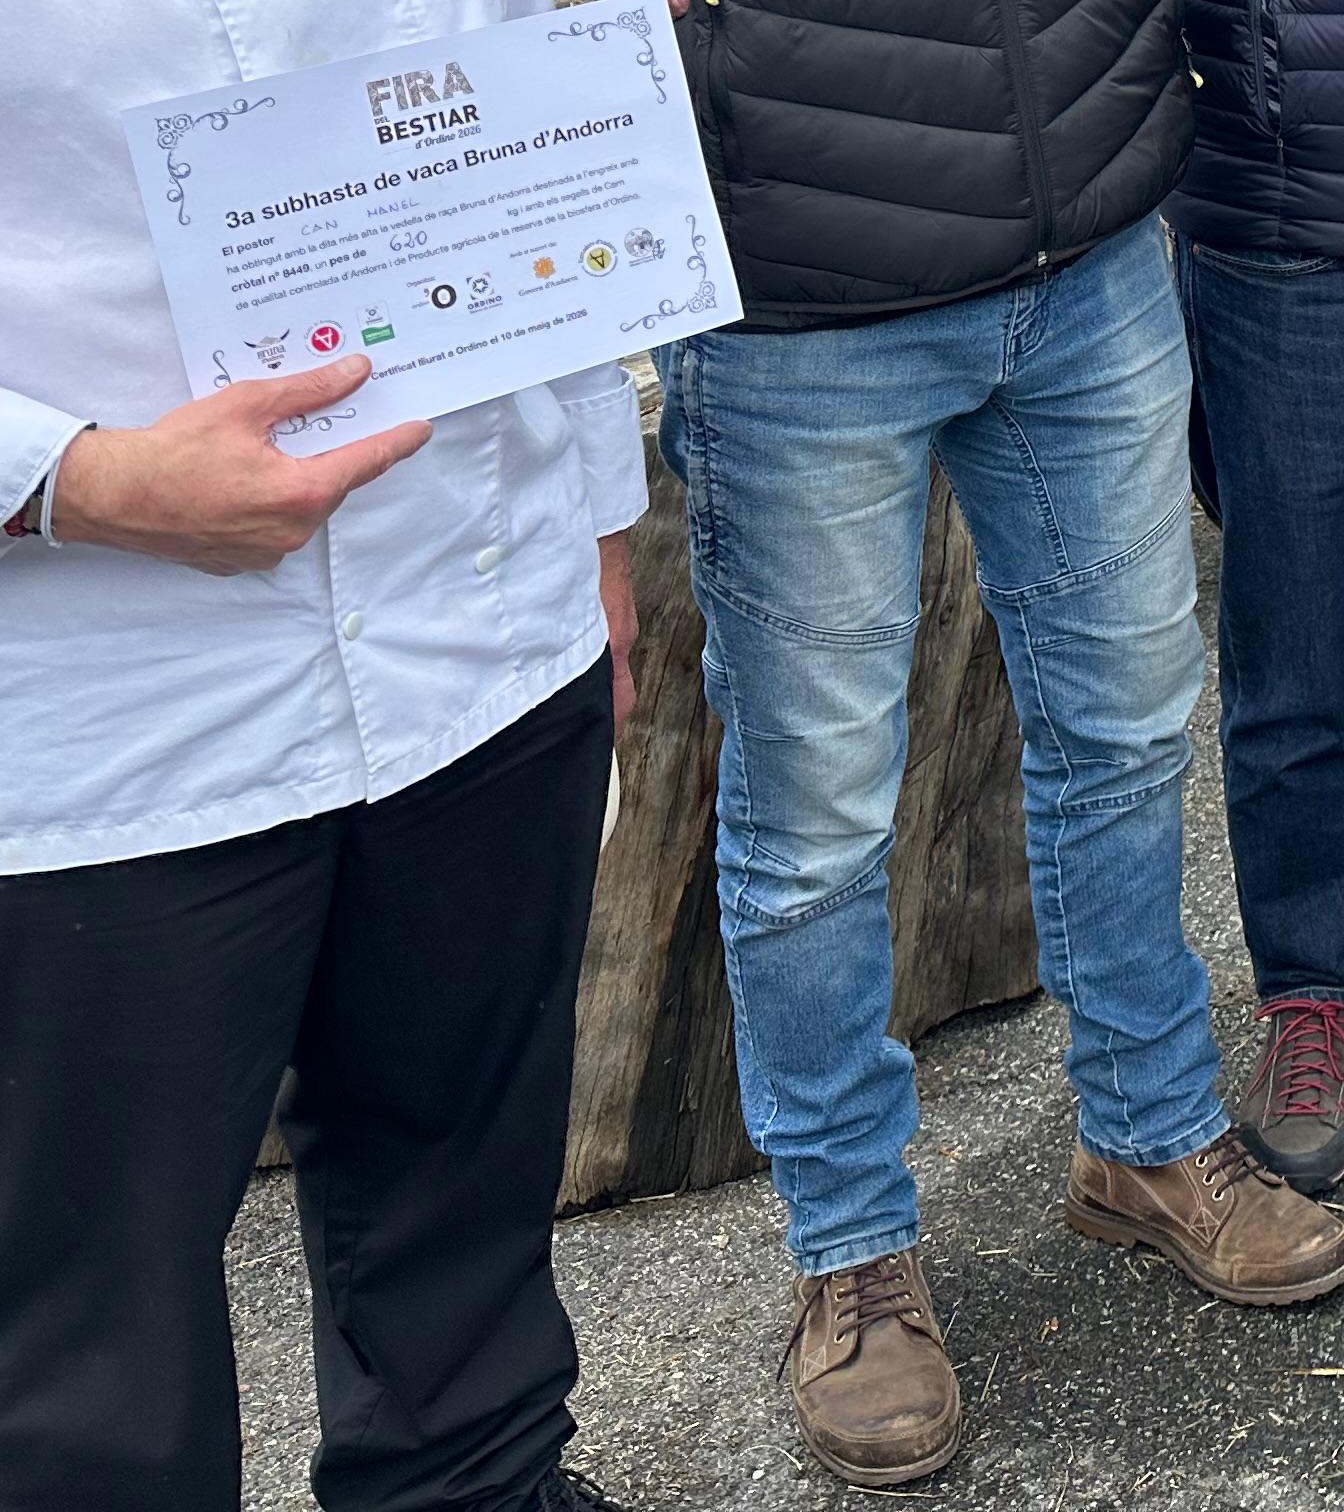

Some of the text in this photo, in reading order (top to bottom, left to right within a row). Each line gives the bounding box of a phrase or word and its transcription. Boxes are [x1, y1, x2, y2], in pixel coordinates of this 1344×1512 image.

[366, 62, 472, 115] FIRA
[377, 104, 478, 144] BESTIAR
[457, 124, 481, 138] 2026
[225, 114, 633, 228] 3a subhasta de vaca Bruna d'Andorra
[225, 265, 240, 274] ha
[241, 253, 281, 270] obtingut
[284, 247, 306, 259] amb
[424, 212, 436, 221] de
[459, 199, 486, 211] Bruna
[487, 187, 531, 203] d'Andorra
[532, 175, 575, 191] destinada
[300, 198, 419, 235] CAN MANEL
[506, 208, 519, 216] kg
[221, 236, 274, 256] El postor
[389, 230, 427, 251] 620
[231, 275, 265, 292] cròtal
[314, 260, 327, 269] un
[329, 254, 350, 267] pes
[352, 249, 366, 259] de
[235, 301, 248, 310] de
[250, 289, 287, 307] qualitat
[288, 276, 339, 295] controlada
[341, 263, 387, 280] d'Andorra
[487, 231, 499, 239] de
[544, 215, 556, 224] de
[467, 295, 502, 309] ORDINO
[369, 360, 416, 380] Certificat
[455, 340, 488, 354] Ordino
[489, 335, 498, 344] el
[500, 331, 512, 340] 10
[513, 328, 526, 337] de
[527, 321, 551, 333] maig
[552, 317, 564, 325] de
